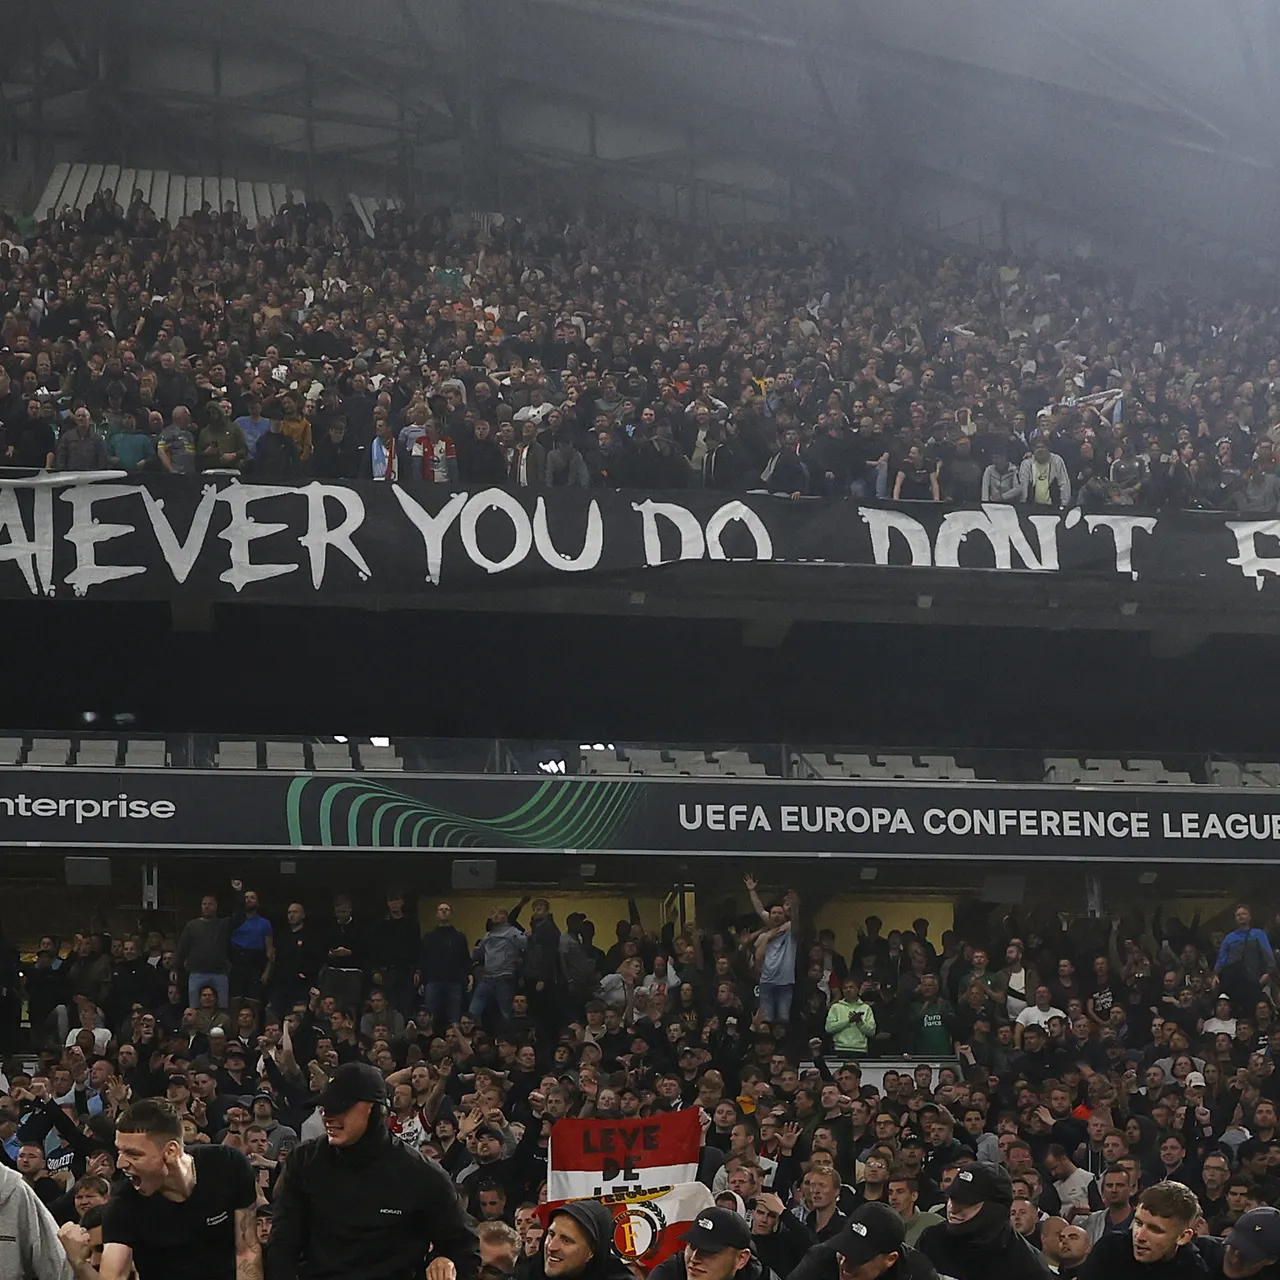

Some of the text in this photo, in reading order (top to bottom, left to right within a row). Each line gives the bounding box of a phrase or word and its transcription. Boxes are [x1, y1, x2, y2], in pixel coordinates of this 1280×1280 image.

[392, 483, 605, 586] YOU
[857, 503, 1158, 582] DON'T
[678, 803, 772, 833] UEFA
[780, 805, 915, 836] EUROPA
[923, 806, 1150, 840] CONFERENCE
[583, 1124, 661, 1154] LEVE
[602, 1154, 640, 1182] DE
